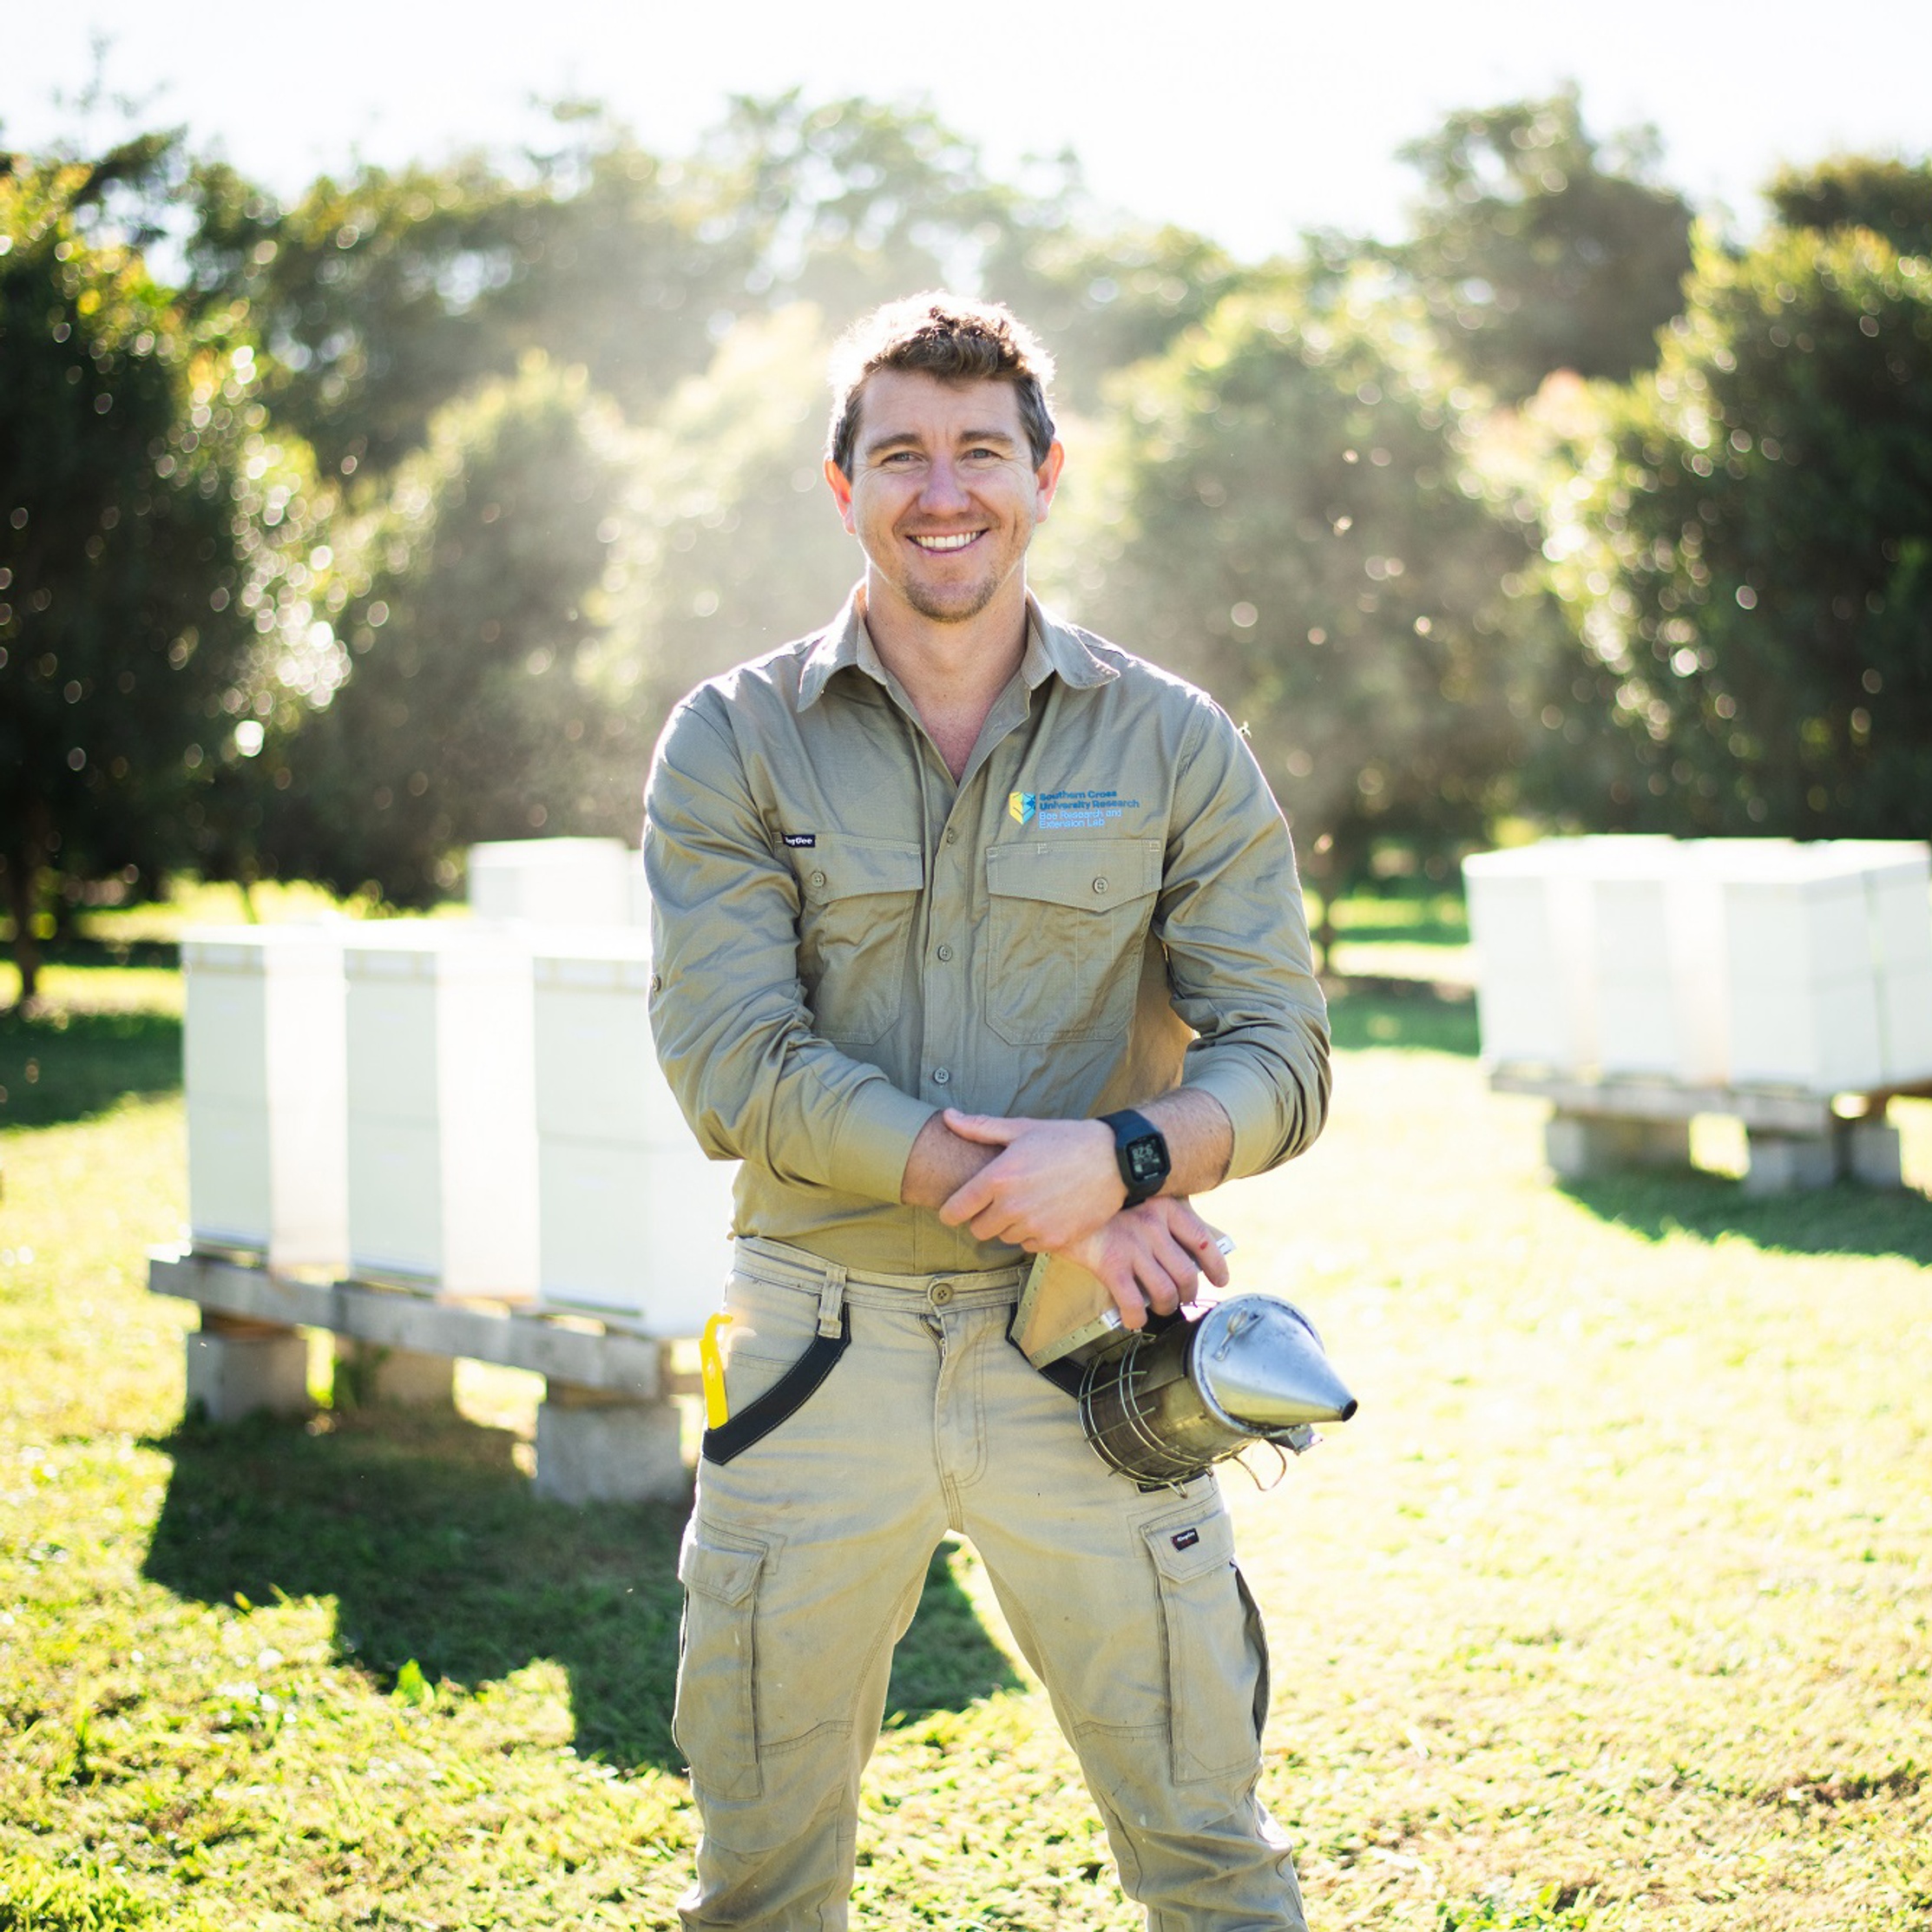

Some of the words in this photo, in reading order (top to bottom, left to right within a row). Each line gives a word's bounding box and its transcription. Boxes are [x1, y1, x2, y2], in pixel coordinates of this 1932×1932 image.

[1040, 791, 1085, 800] Southern
[1040, 800, 1091, 811] University
[1093, 799, 1140, 808] Research
[1040, 812, 1057, 820] Bee
[1060, 809, 1103, 818] Research
[1106, 809, 1121, 818] and
[1040, 820, 1084, 829] Extension
[1088, 818, 1105, 827] Lab
